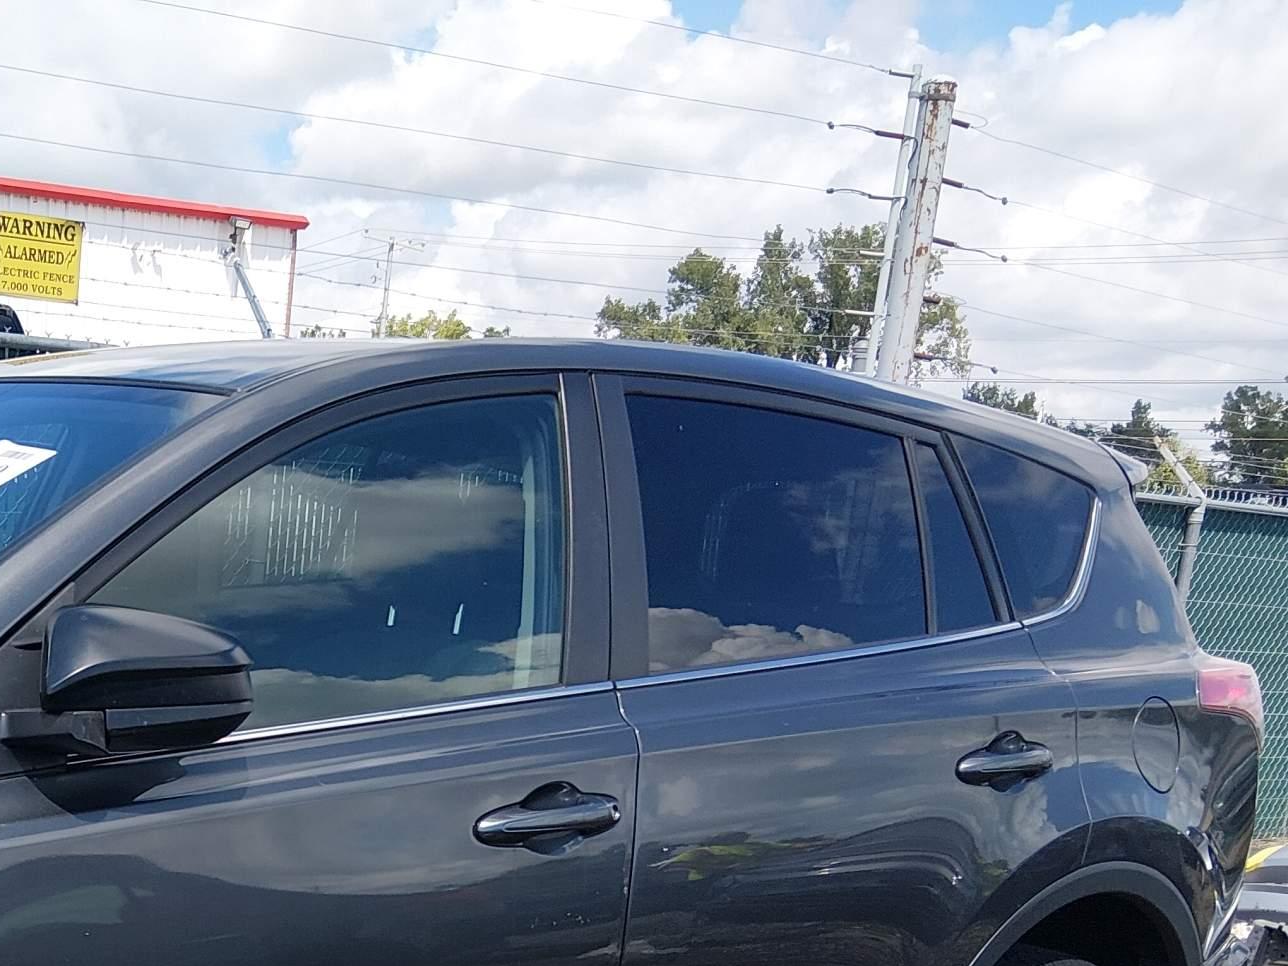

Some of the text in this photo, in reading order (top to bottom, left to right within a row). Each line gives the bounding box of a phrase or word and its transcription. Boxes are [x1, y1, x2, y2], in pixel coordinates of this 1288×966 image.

[4, 245, 64, 265] ALARMED
[42, 271, 75, 284] FENCE
[1, 280, 63, 296] 7,000 VOLTS
